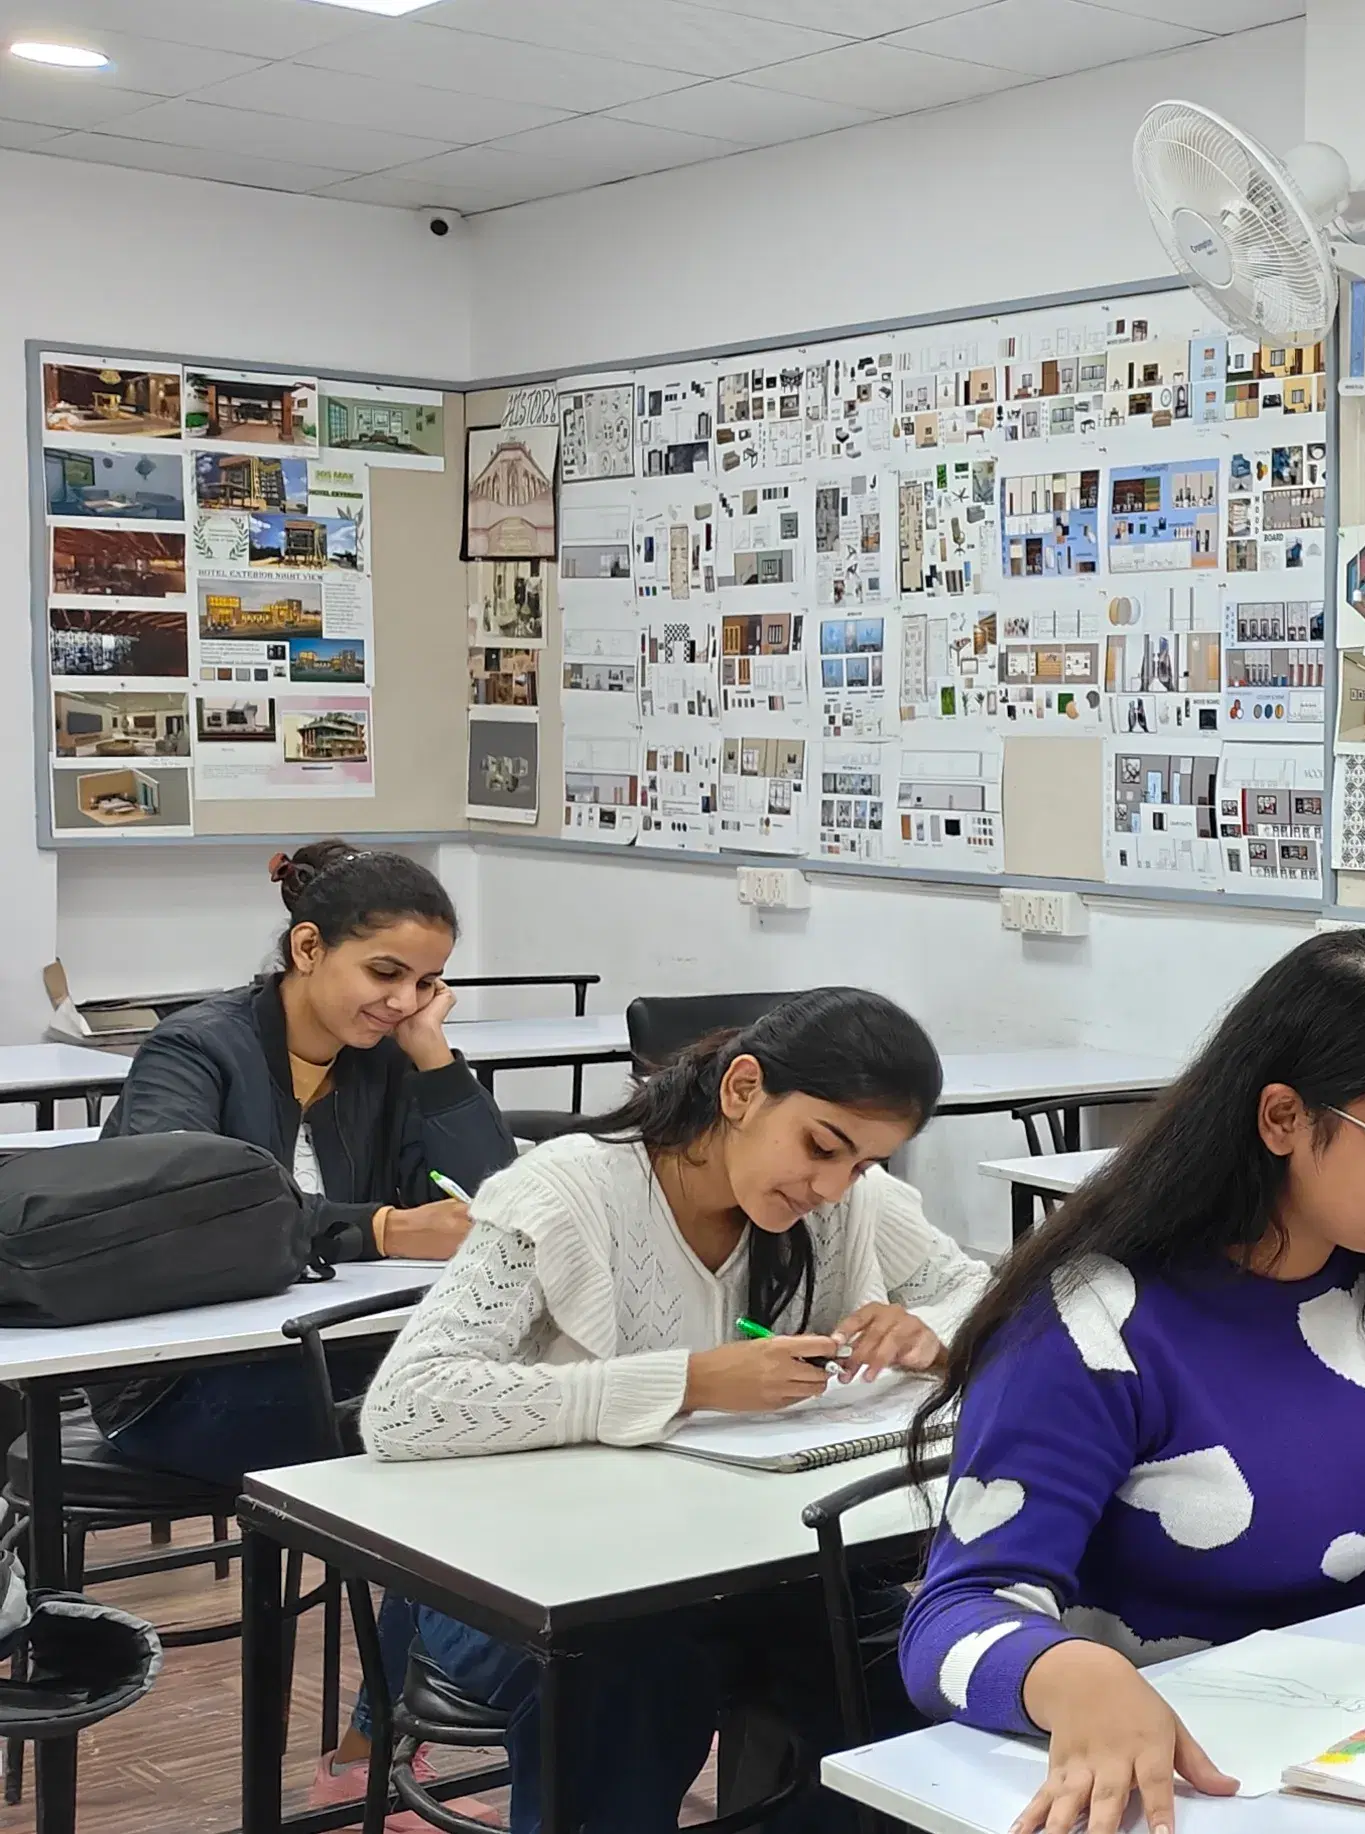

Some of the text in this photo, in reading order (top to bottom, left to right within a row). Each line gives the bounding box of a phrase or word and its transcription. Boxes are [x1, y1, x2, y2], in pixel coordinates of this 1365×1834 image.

[501, 388, 559, 427] HISTORY
[1263, 532, 1284, 542] BOARD
[198, 568, 228, 578] HOTEL
[229, 569, 274, 580] EXTERIOR
